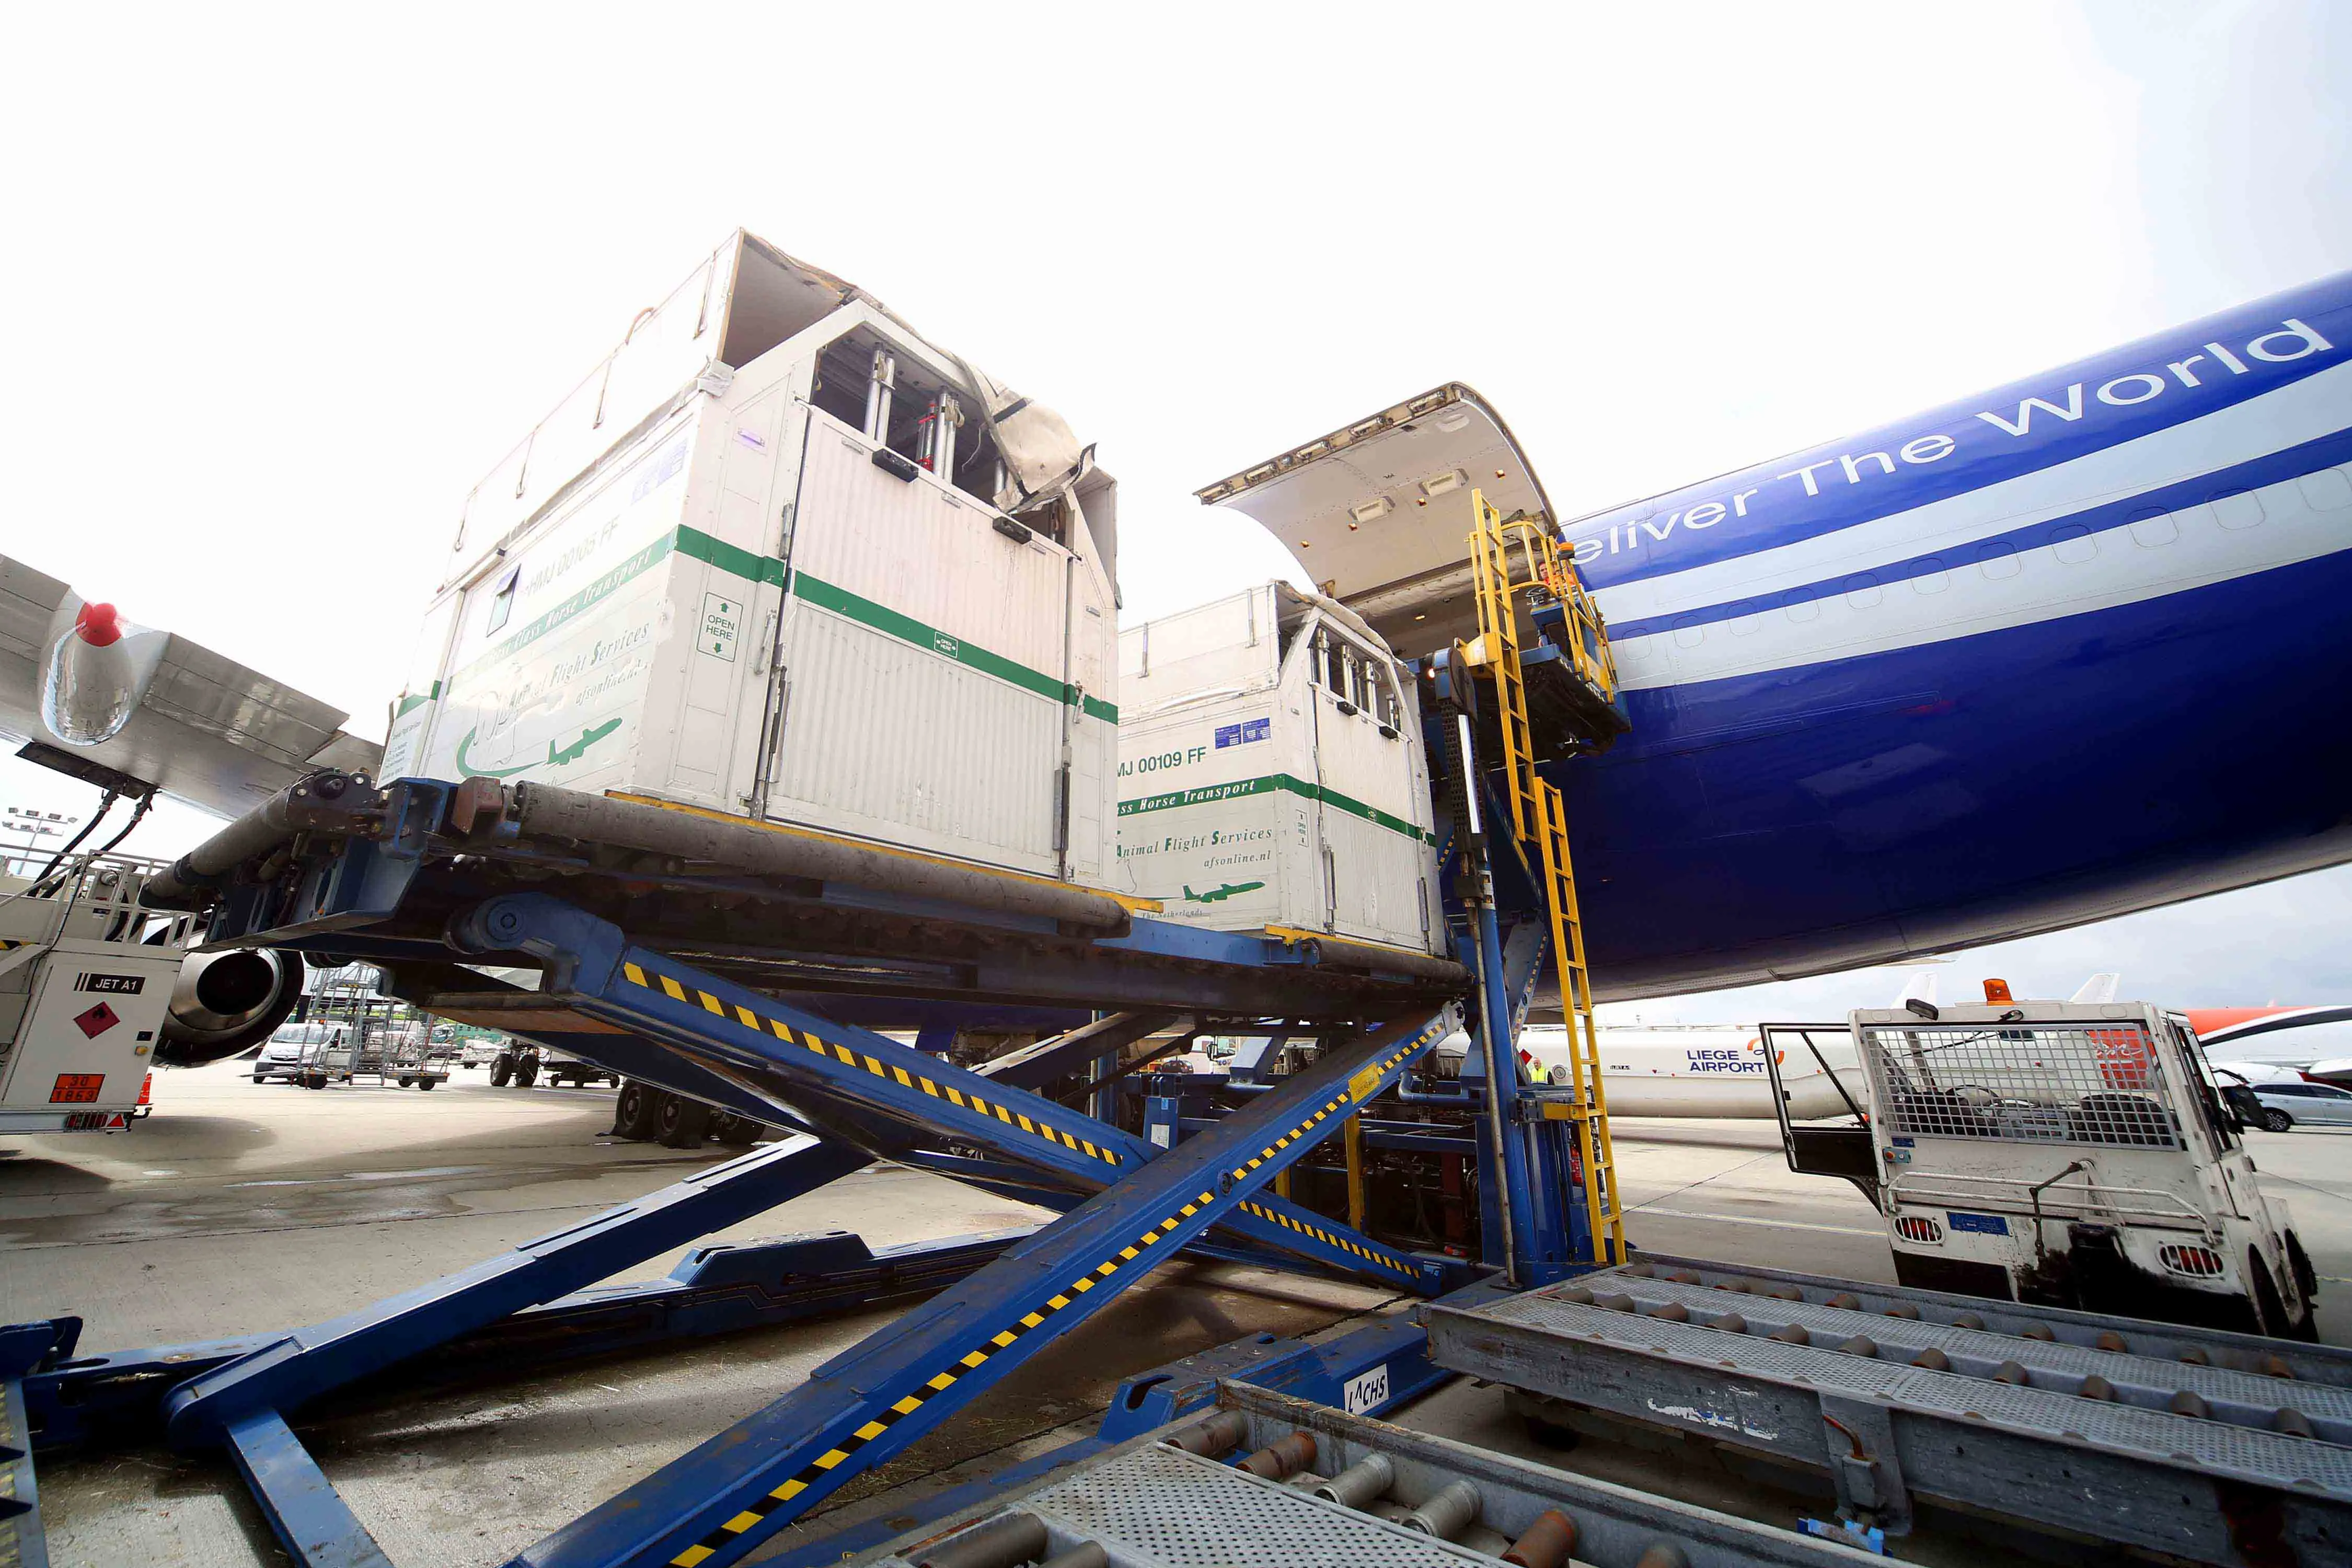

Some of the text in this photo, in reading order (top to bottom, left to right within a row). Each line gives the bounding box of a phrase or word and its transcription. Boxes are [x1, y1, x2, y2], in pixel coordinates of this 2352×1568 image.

[1778, 434, 1955, 497] The
[1975, 318, 2334, 436] World
[583, 548, 651, 605] Transport
[708, 614, 735, 631] OPEN
[706, 624, 733, 641] HERE
[549, 653, 586, 688] Flight
[591, 622, 649, 665] Services
[1138, 751, 1182, 773] 00109
[1187, 746, 1207, 764] FF
[1139, 795, 1176, 811] Horse
[1184, 779, 1255, 799] Transport
[1165, 836, 1206, 852] Flight
[1212, 828, 1273, 846] Services
[1204, 850, 1271, 869] afsonline.nl
[96, 978, 137, 990] JET A1
[1686, 1050, 1739, 1061] LIEGE
[1689, 1062, 1765, 1074] AIRPORT
[70, 1076, 89, 1087] 30
